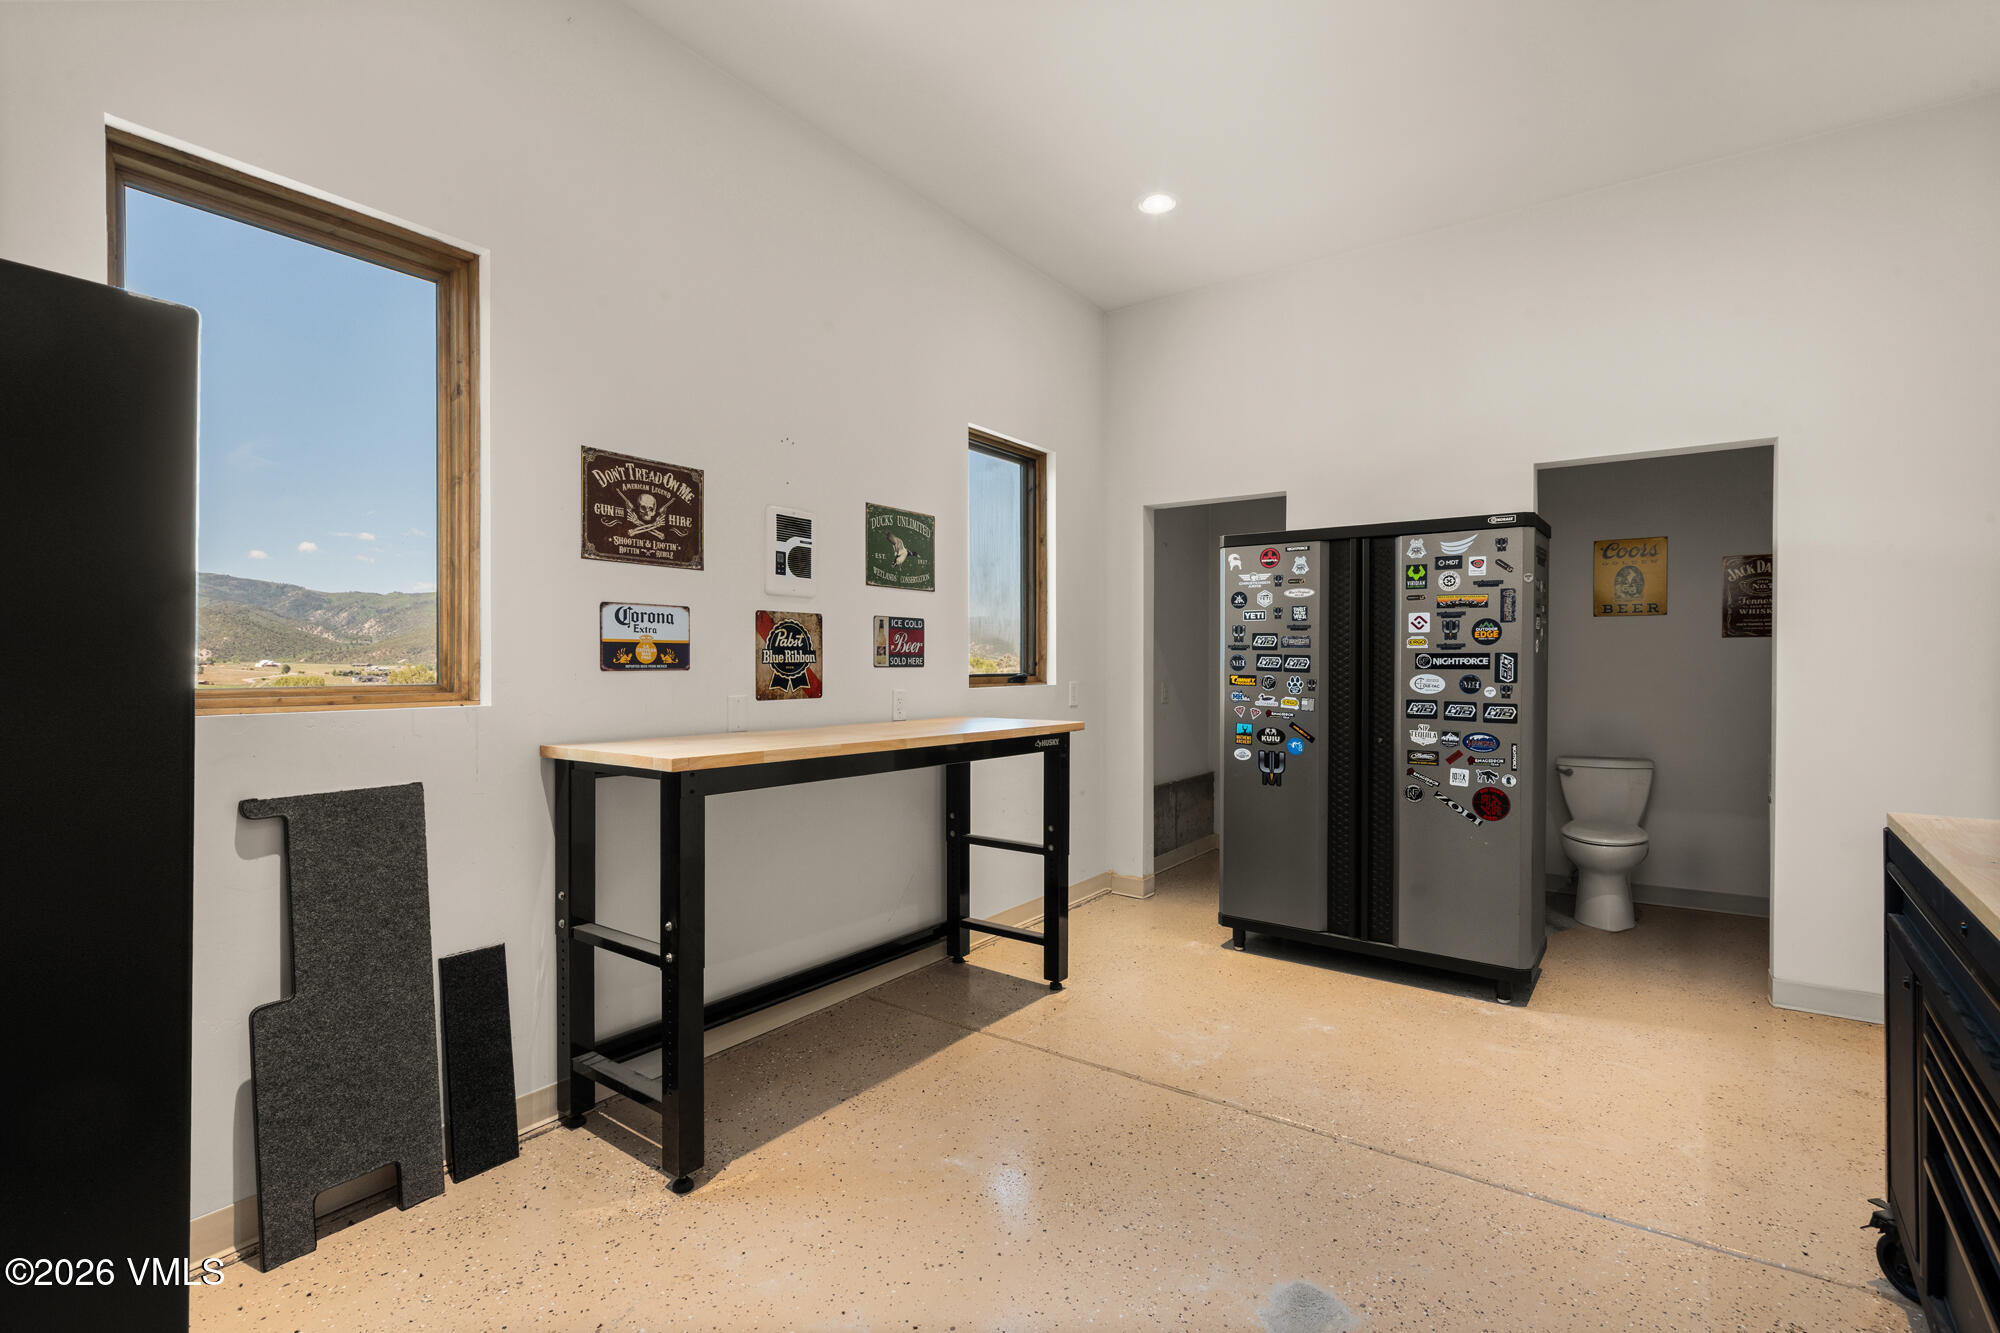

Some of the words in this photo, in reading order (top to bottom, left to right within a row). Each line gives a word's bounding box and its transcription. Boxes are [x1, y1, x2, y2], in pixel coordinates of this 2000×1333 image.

[622, 483, 650, 491] AMERICAN
[625, 463, 663, 485] TREAD
[677, 482, 695, 504] ME
[594, 503, 614, 517] GUN
[668, 514, 693, 528] HIRE
[871, 514, 894, 529] DUCKS
[897, 515, 931, 538] UNLIMITED
[645, 540, 652, 548] &
[1600, 542, 1659, 560] Coors
[1727, 564, 1756, 582] JACK
[1738, 596, 1772, 605] Tenne
[1601, 603, 1659, 614] BEER
[614, 605, 674, 628] Corona
[633, 624, 657, 634] Extra
[891, 619, 902, 627] ICE
[904, 620, 923, 628] COLD
[774, 628, 804, 647] Pabst
[1474, 630, 1500, 638] EDGE
[890, 631, 923, 653] Beer
[762, 650, 784, 664] Blue
[785, 649, 816, 663] Ribbon
[890, 657, 906, 665] SOLD
[907, 657, 924, 665] HERE
[1432, 657, 1489, 666] NIGHTFORCE
[1410, 731, 1437, 739] TEQUILA
[1041, 738, 1060, 747] HUSKY
[1434, 790, 1482, 825] ZOLI
